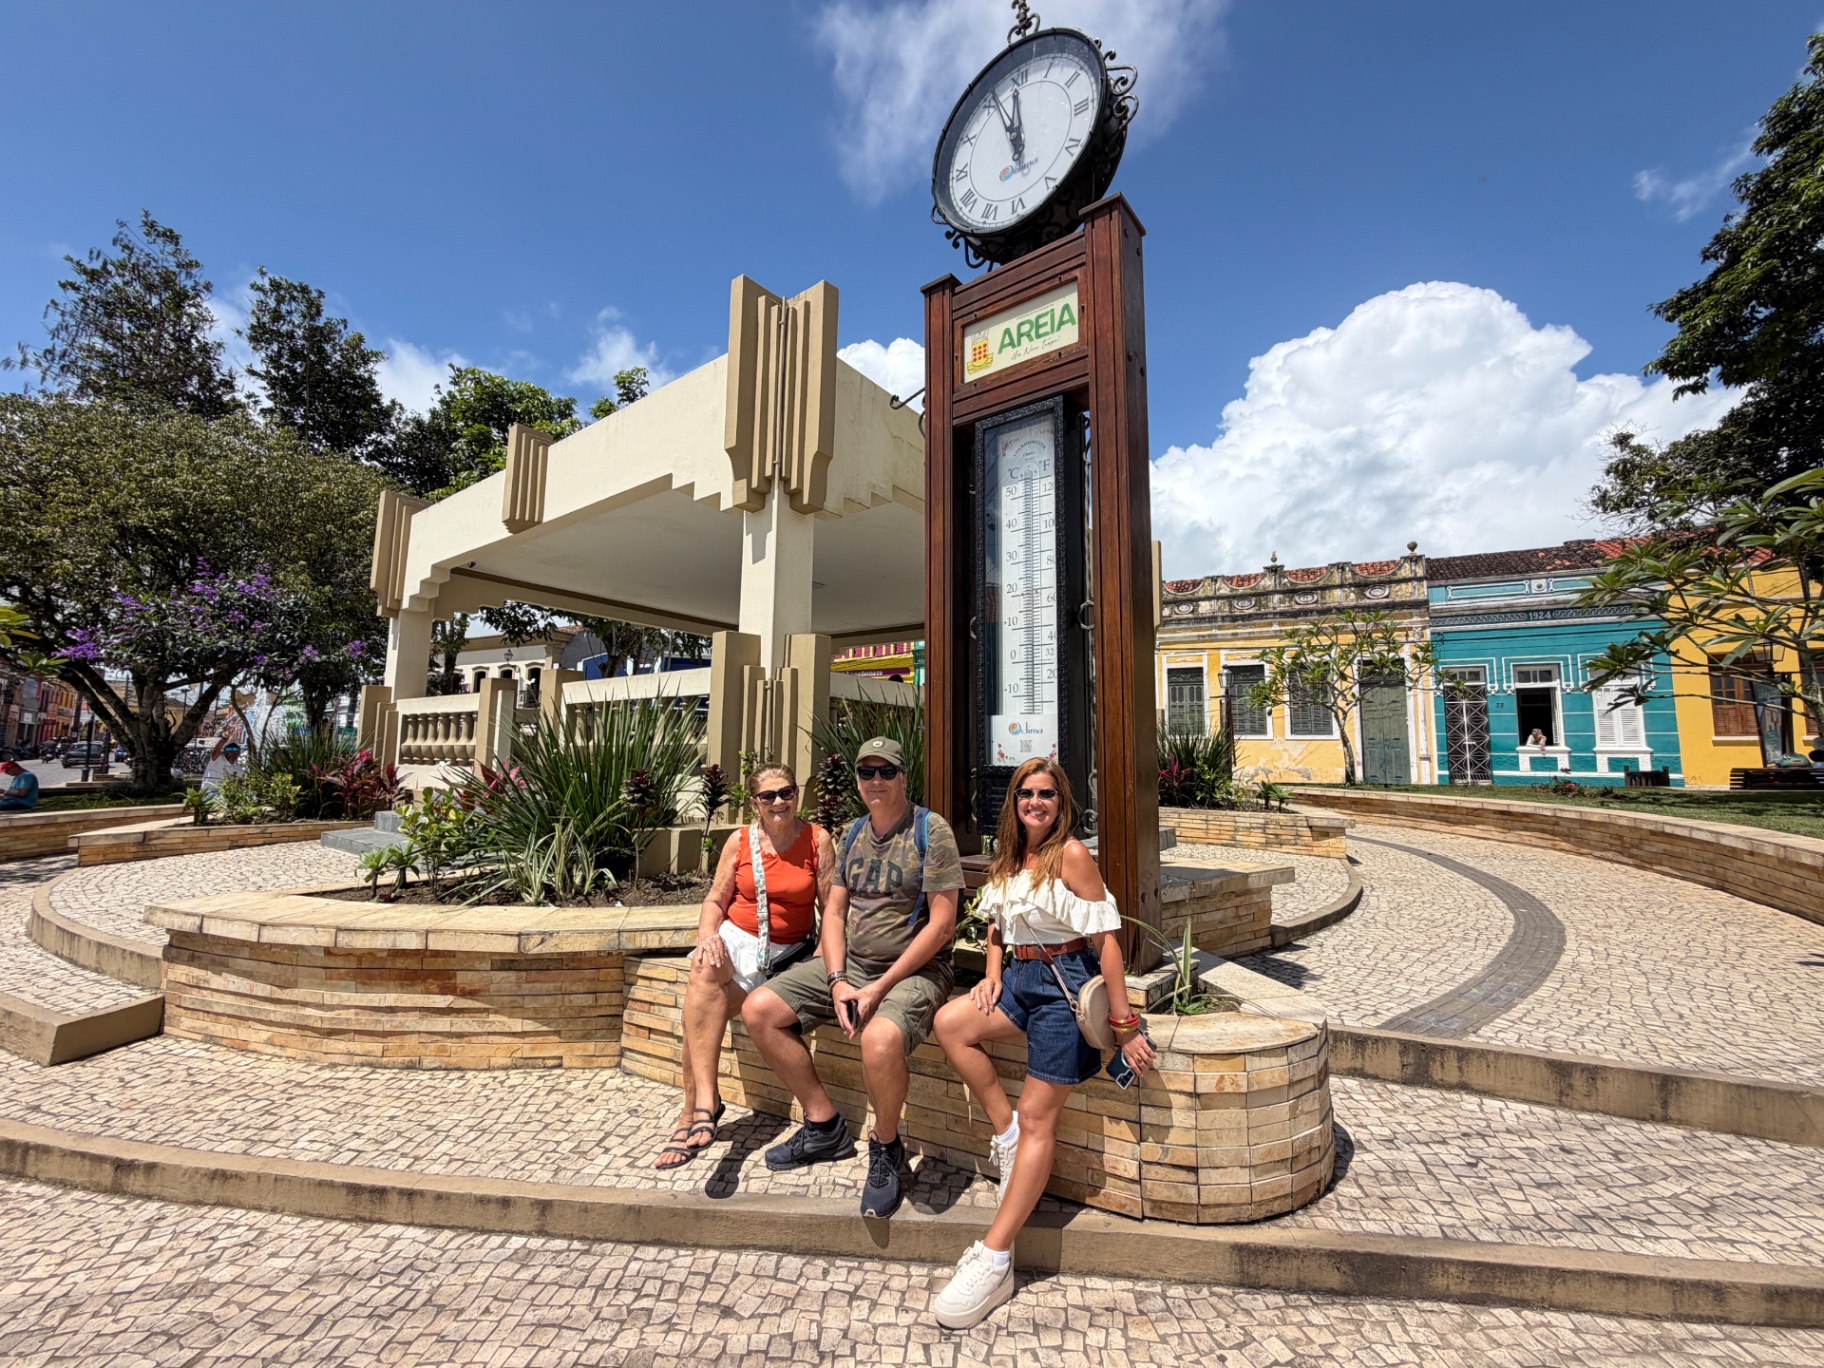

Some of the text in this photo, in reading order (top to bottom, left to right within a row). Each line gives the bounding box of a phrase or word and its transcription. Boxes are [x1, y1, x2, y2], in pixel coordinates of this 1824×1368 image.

[1010, 69, 1028, 92] XII
[1065, 70, 1080, 88] II
[1074, 96, 1089, 118] III
[962, 133, 977, 147] X
[1065, 137, 1082, 157] IV
[956, 162, 968, 183] IX
[1044, 176, 1058, 190] V
[960, 188, 978, 213] VIII
[1011, 196, 1026, 215] VI
[981, 203, 998, 220] VII
[1005, 485, 1017, 497] 50
[1005, 518, 1018, 529] 40
[1005, 550, 1018, 562] 30
[1006, 583, 1018, 594] 20
[1528, 611, 1552, 620] 1924
[1010, 649, 1017, 660] 0
[1045, 648, 1055, 656] 32
[848, 857, 903, 895] GAP
